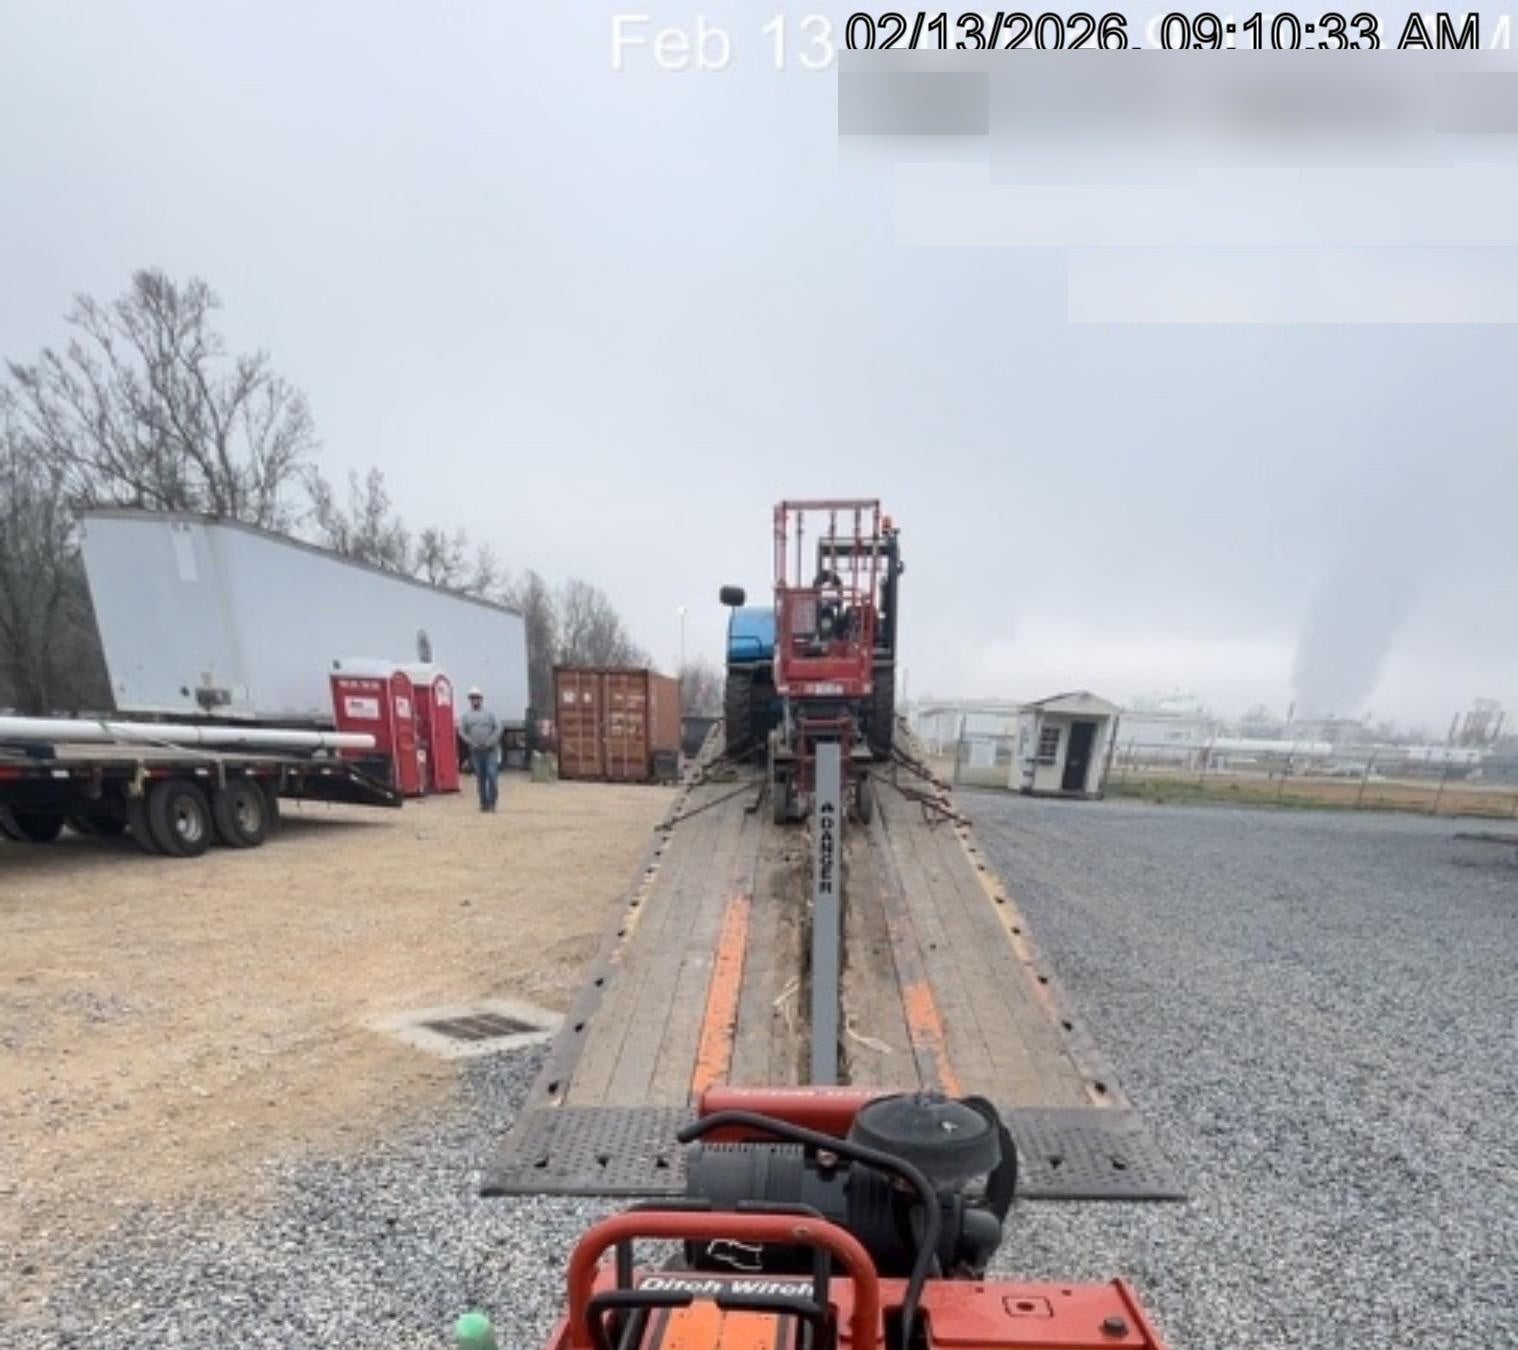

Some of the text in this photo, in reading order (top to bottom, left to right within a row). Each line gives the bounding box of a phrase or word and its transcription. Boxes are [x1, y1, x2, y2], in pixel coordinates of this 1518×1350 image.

[819, 816, 833, 895] DANGER
[638, 1277, 814, 1296] Ditch Witch
